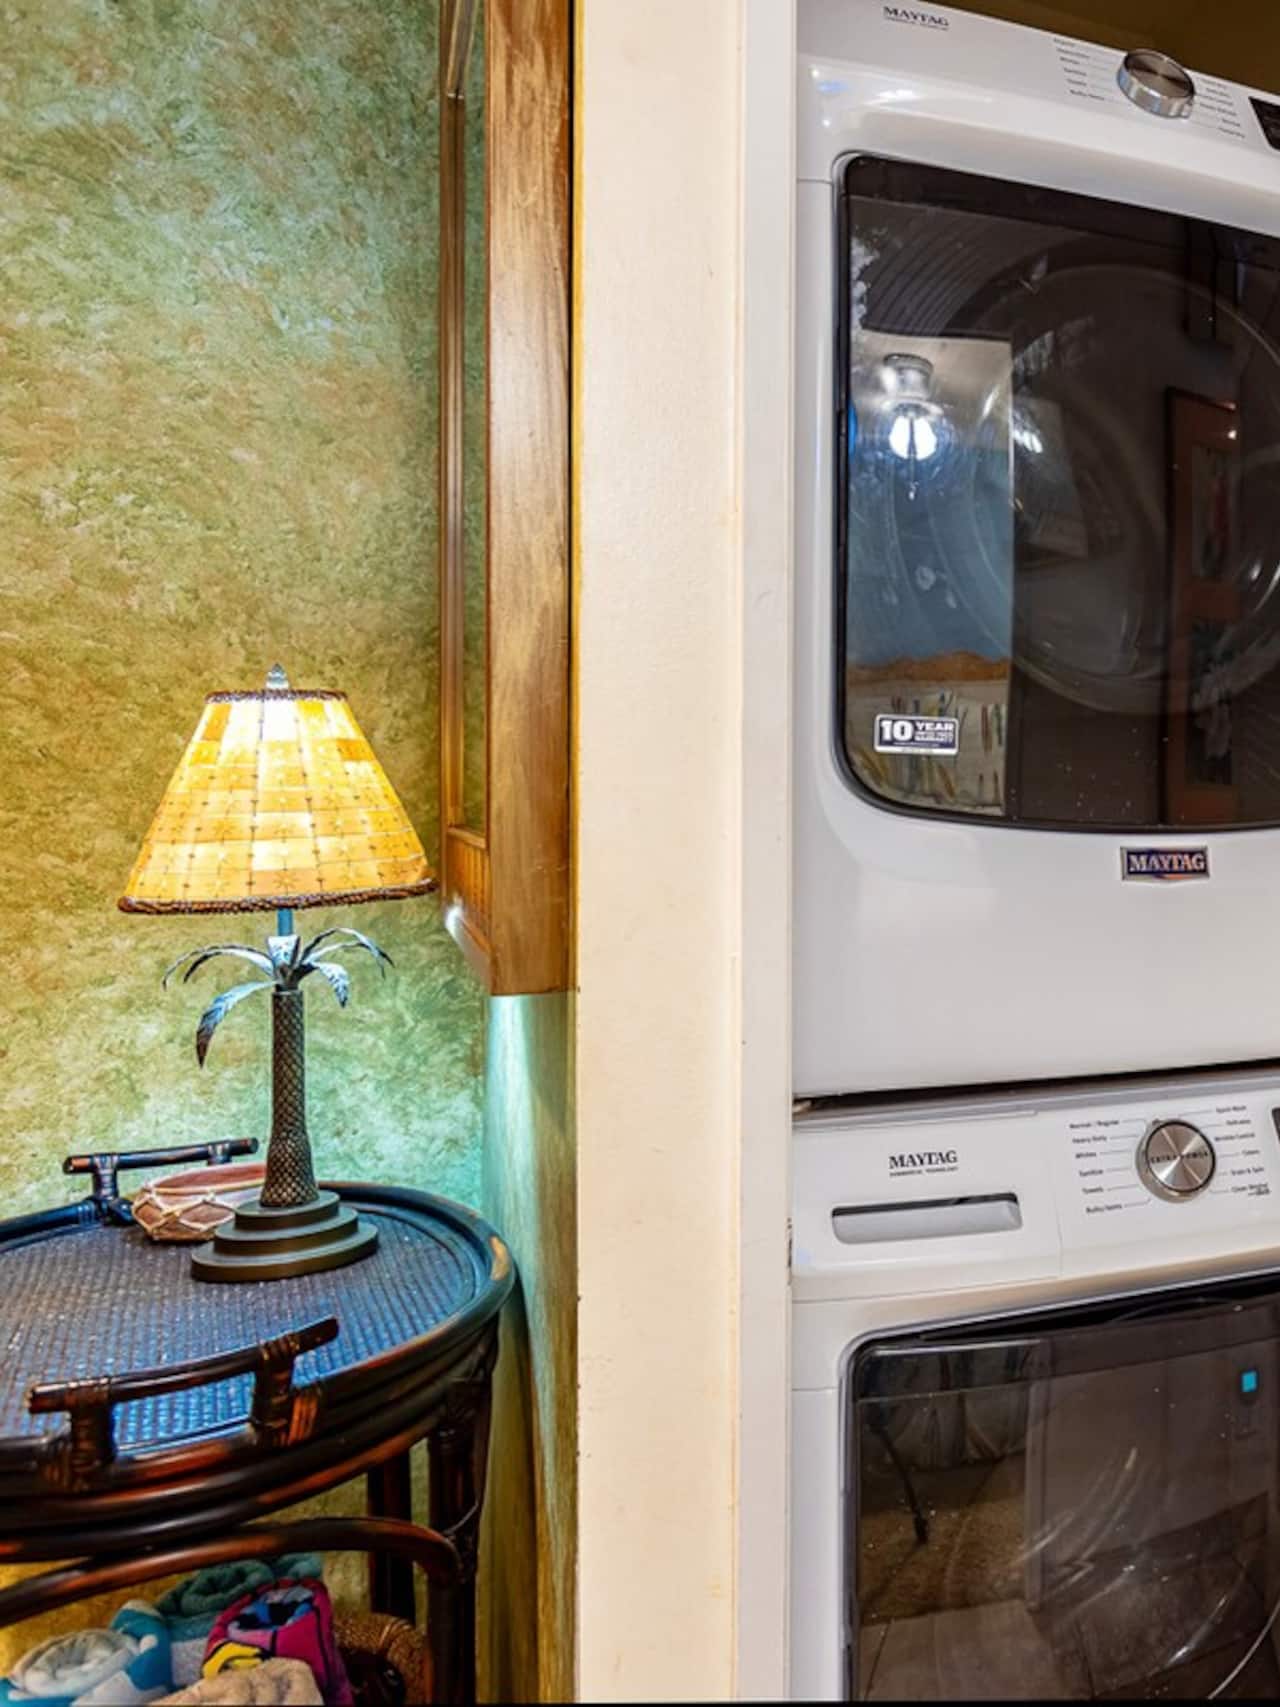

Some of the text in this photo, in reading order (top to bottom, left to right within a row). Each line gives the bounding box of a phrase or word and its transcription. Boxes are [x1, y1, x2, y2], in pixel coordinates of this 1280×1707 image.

[883, 6, 949, 26] MAYTAG
[881, 720, 914, 741] 10
[914, 721, 955, 731] YEAR
[1128, 853, 1206, 872] MAYTAG
[889, 1150, 958, 1169] MAYTAG
